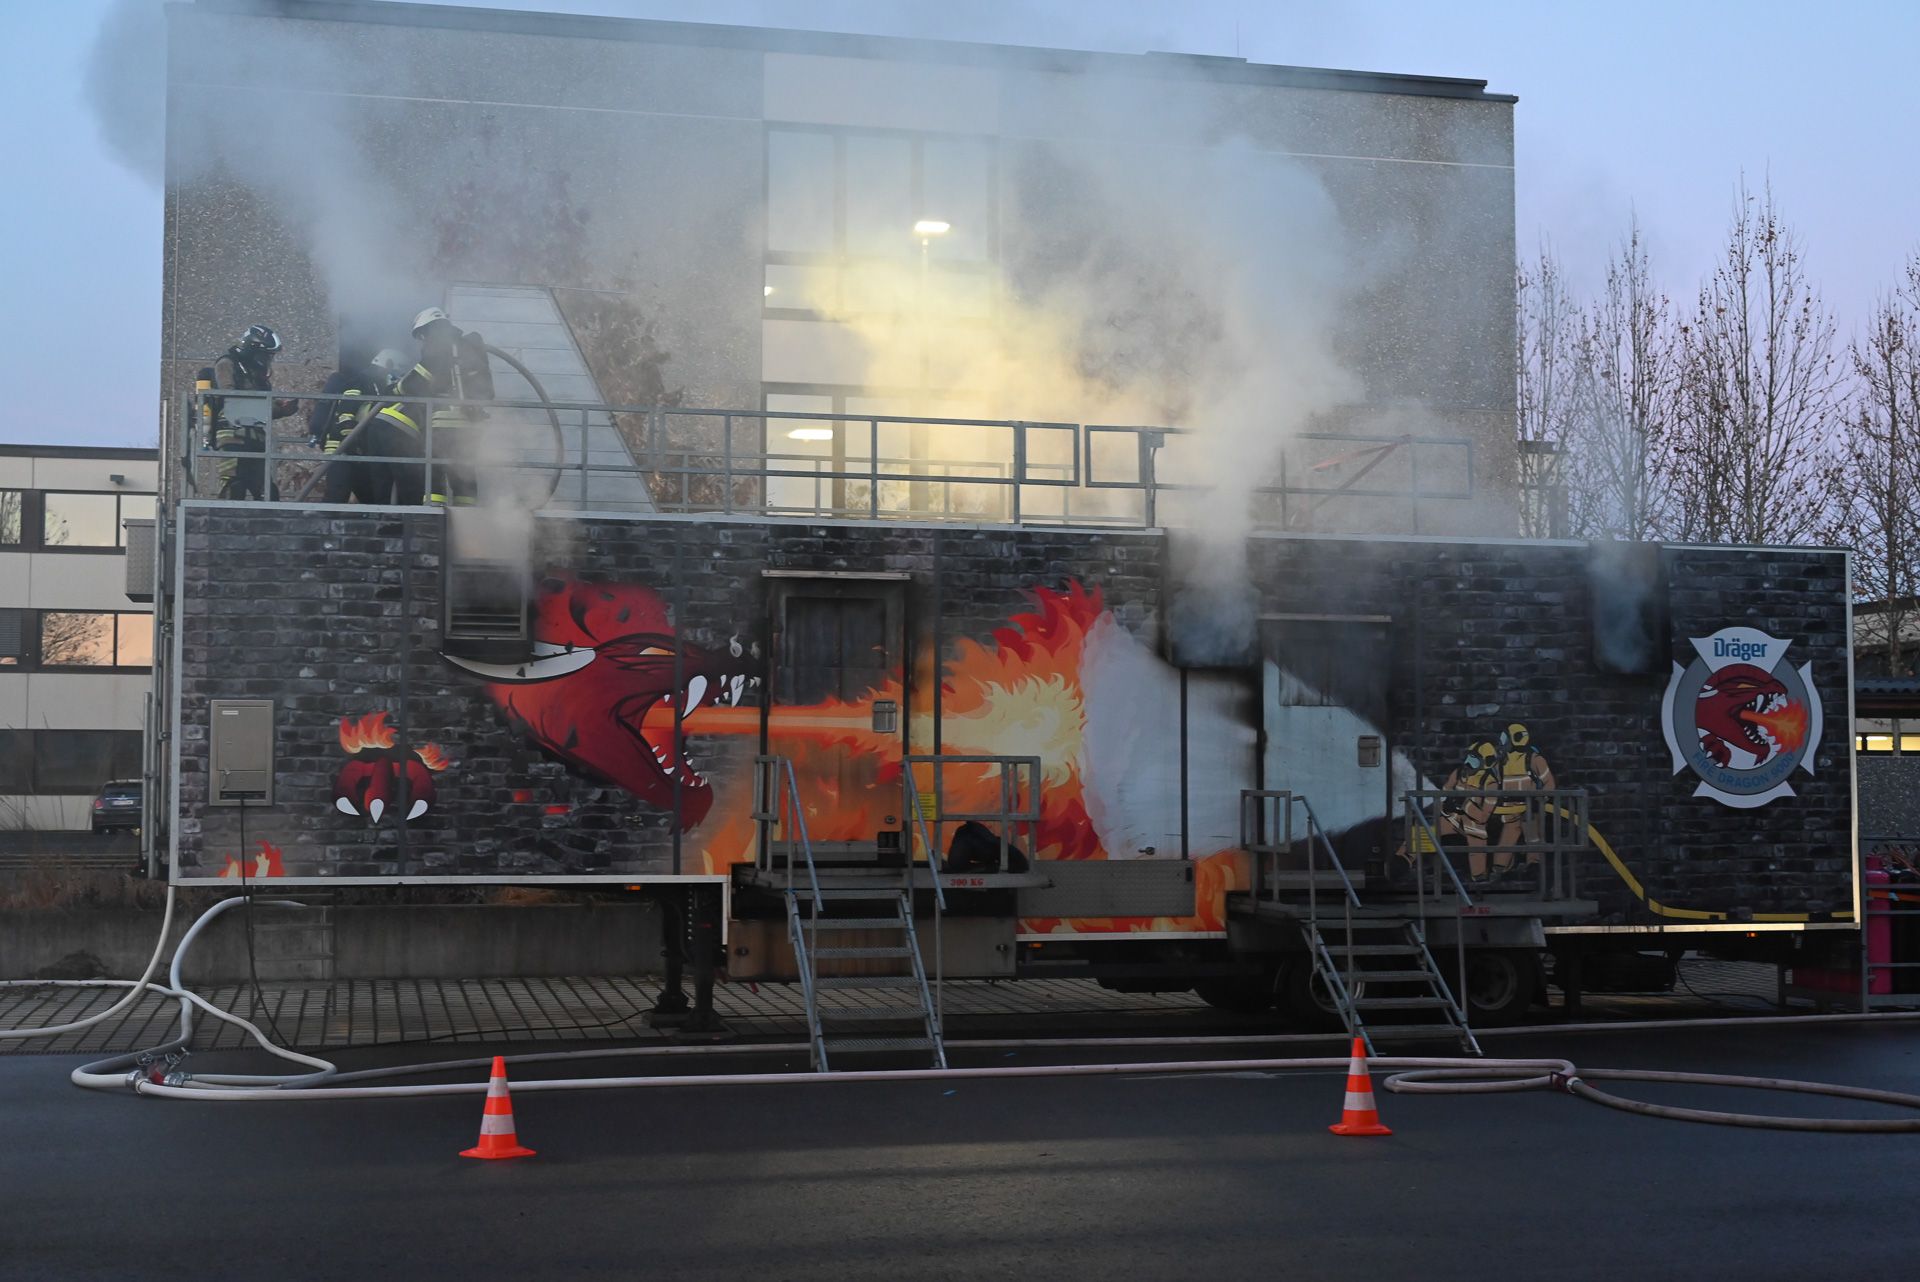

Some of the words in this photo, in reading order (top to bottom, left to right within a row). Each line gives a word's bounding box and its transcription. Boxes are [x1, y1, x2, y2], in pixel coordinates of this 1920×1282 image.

[1713, 638, 1768, 661] Dräger
[1691, 752, 1715, 777] FIRE
[1718, 772, 1769, 787] DRAGON
